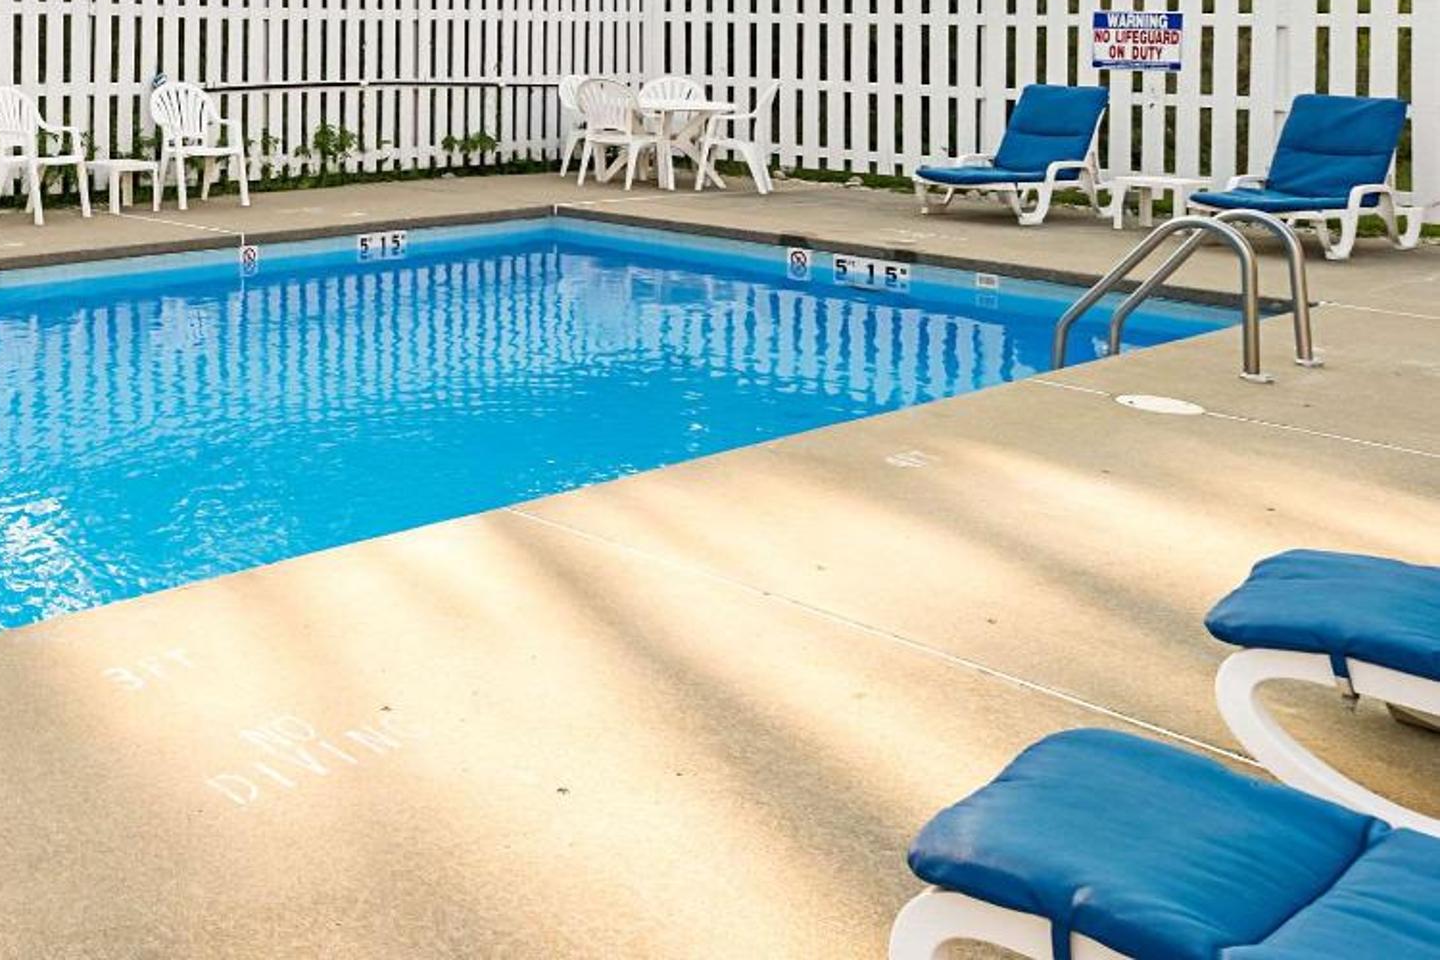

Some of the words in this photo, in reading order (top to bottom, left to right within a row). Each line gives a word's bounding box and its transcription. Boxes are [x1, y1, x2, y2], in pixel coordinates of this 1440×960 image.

[1108, 14, 1168, 29] WARNING
[1094, 30, 1109, 43] NO
[1116, 31, 1180, 45] LIFEGUARD
[1109, 45, 1125, 58] ON
[1133, 47, 1163, 60] DUTY
